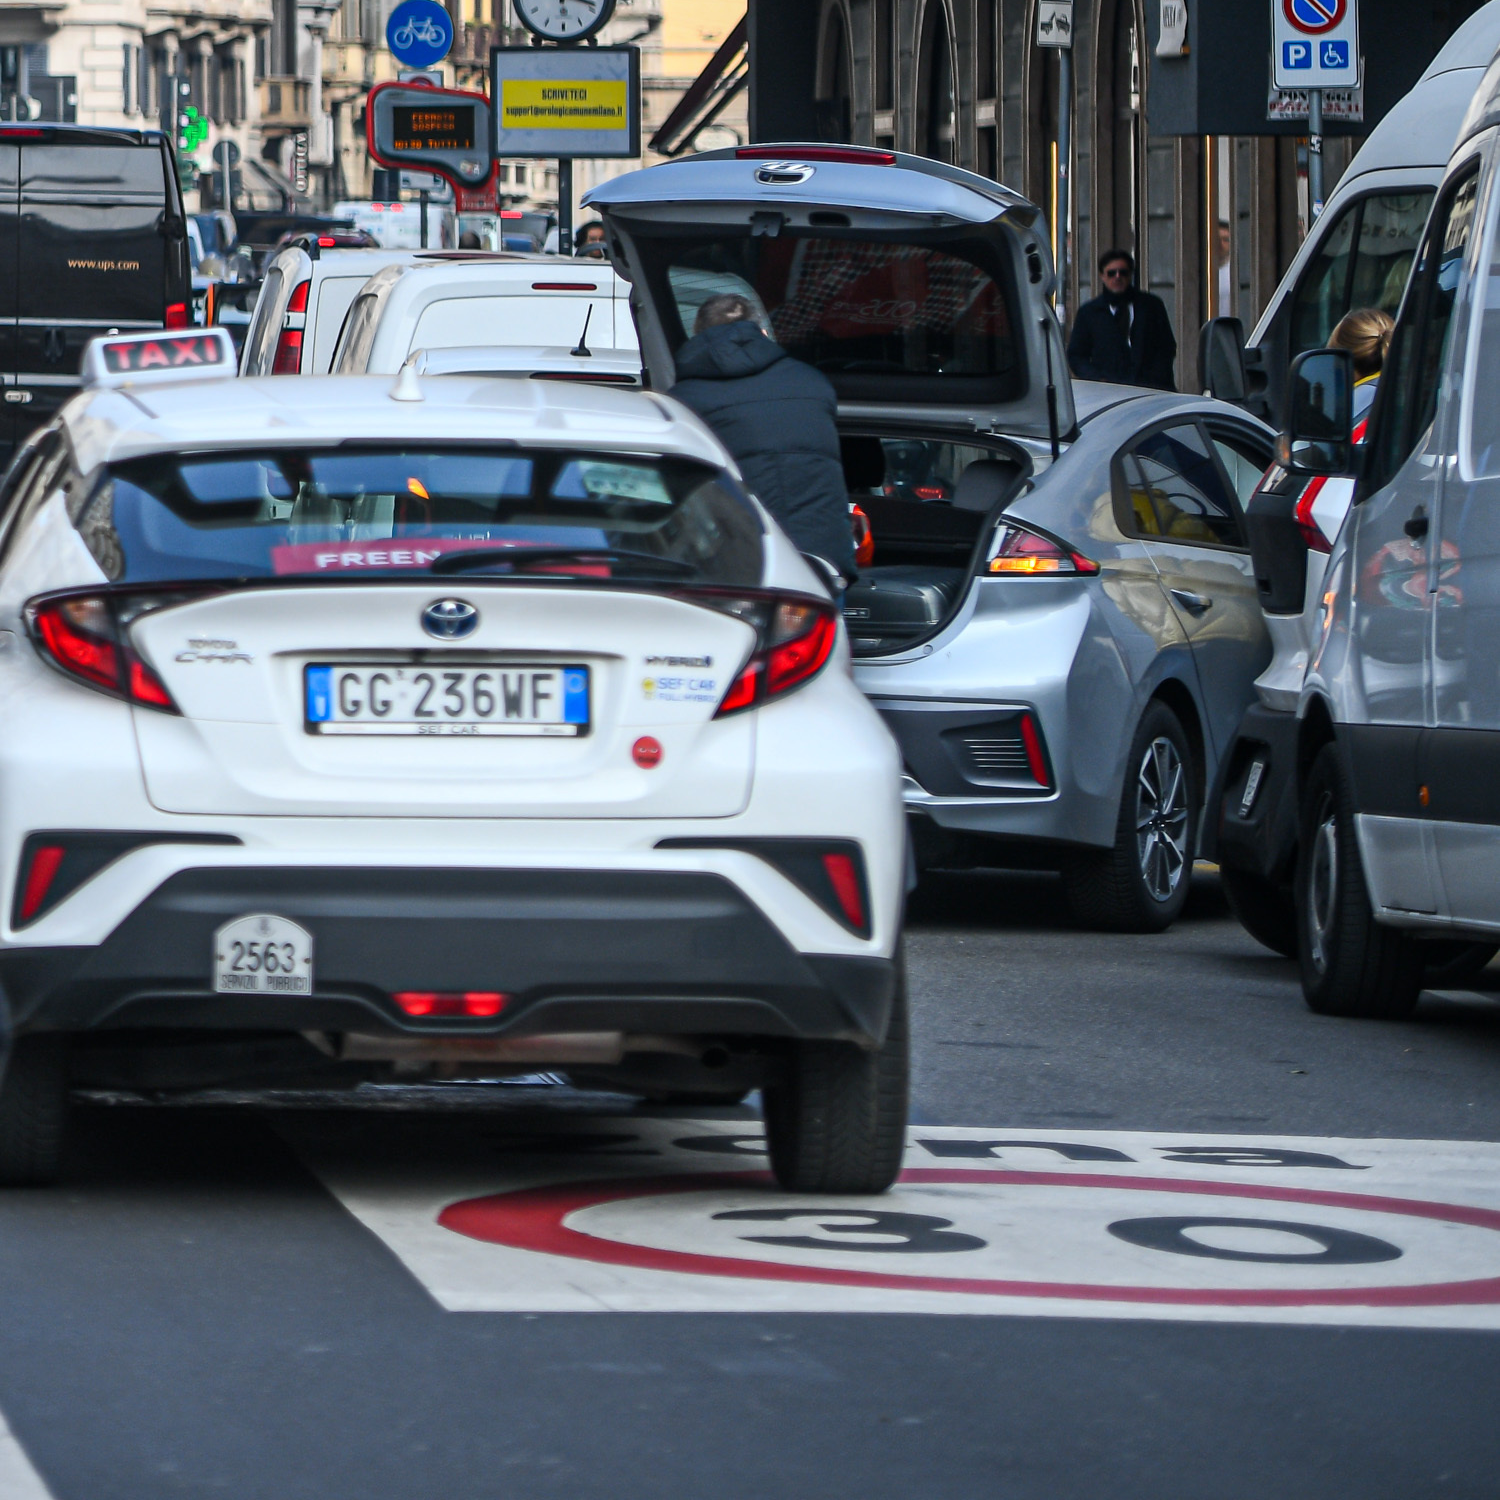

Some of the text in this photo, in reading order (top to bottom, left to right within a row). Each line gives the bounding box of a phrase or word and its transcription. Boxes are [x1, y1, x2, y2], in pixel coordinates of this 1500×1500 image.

[1289, 44, 1306, 67] P
[541, 88, 587, 100] SCRIVETECI
[67, 258, 140, 271] www.ups.com
[108, 336, 218, 369] TAXI
[315, 550, 441, 568] FREEN
[231, 941, 296, 973] 2563
[221, 975, 307, 991] SERVIZIO PUBBLICO
